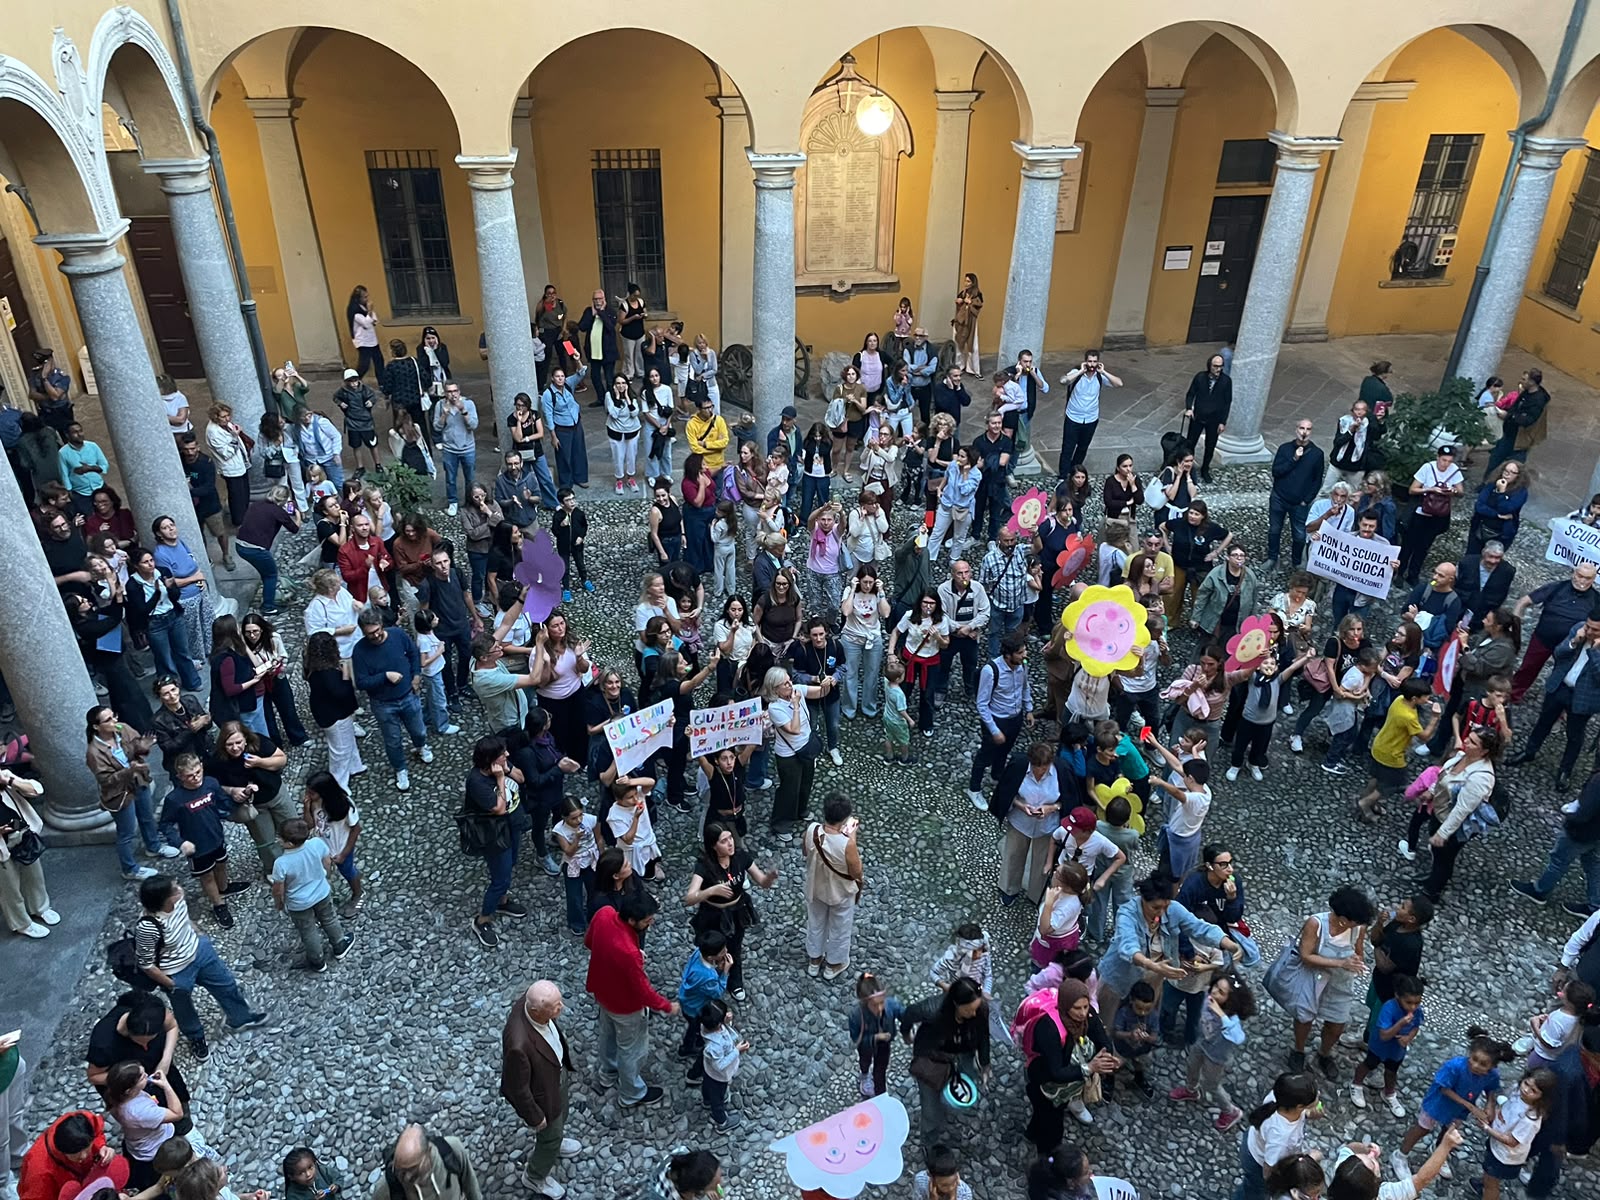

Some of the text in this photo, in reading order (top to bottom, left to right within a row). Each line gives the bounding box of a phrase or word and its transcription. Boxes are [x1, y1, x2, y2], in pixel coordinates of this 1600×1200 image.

[1565, 524, 1600, 550] SCUOL
[1321, 533, 1389, 566] CON LA SCUOLA
[1313, 560, 1331, 571] BASTA
[1317, 544, 1385, 579] NON SI GIOCA
[629, 715, 642, 728] LE
[721, 710, 735, 722] LE
